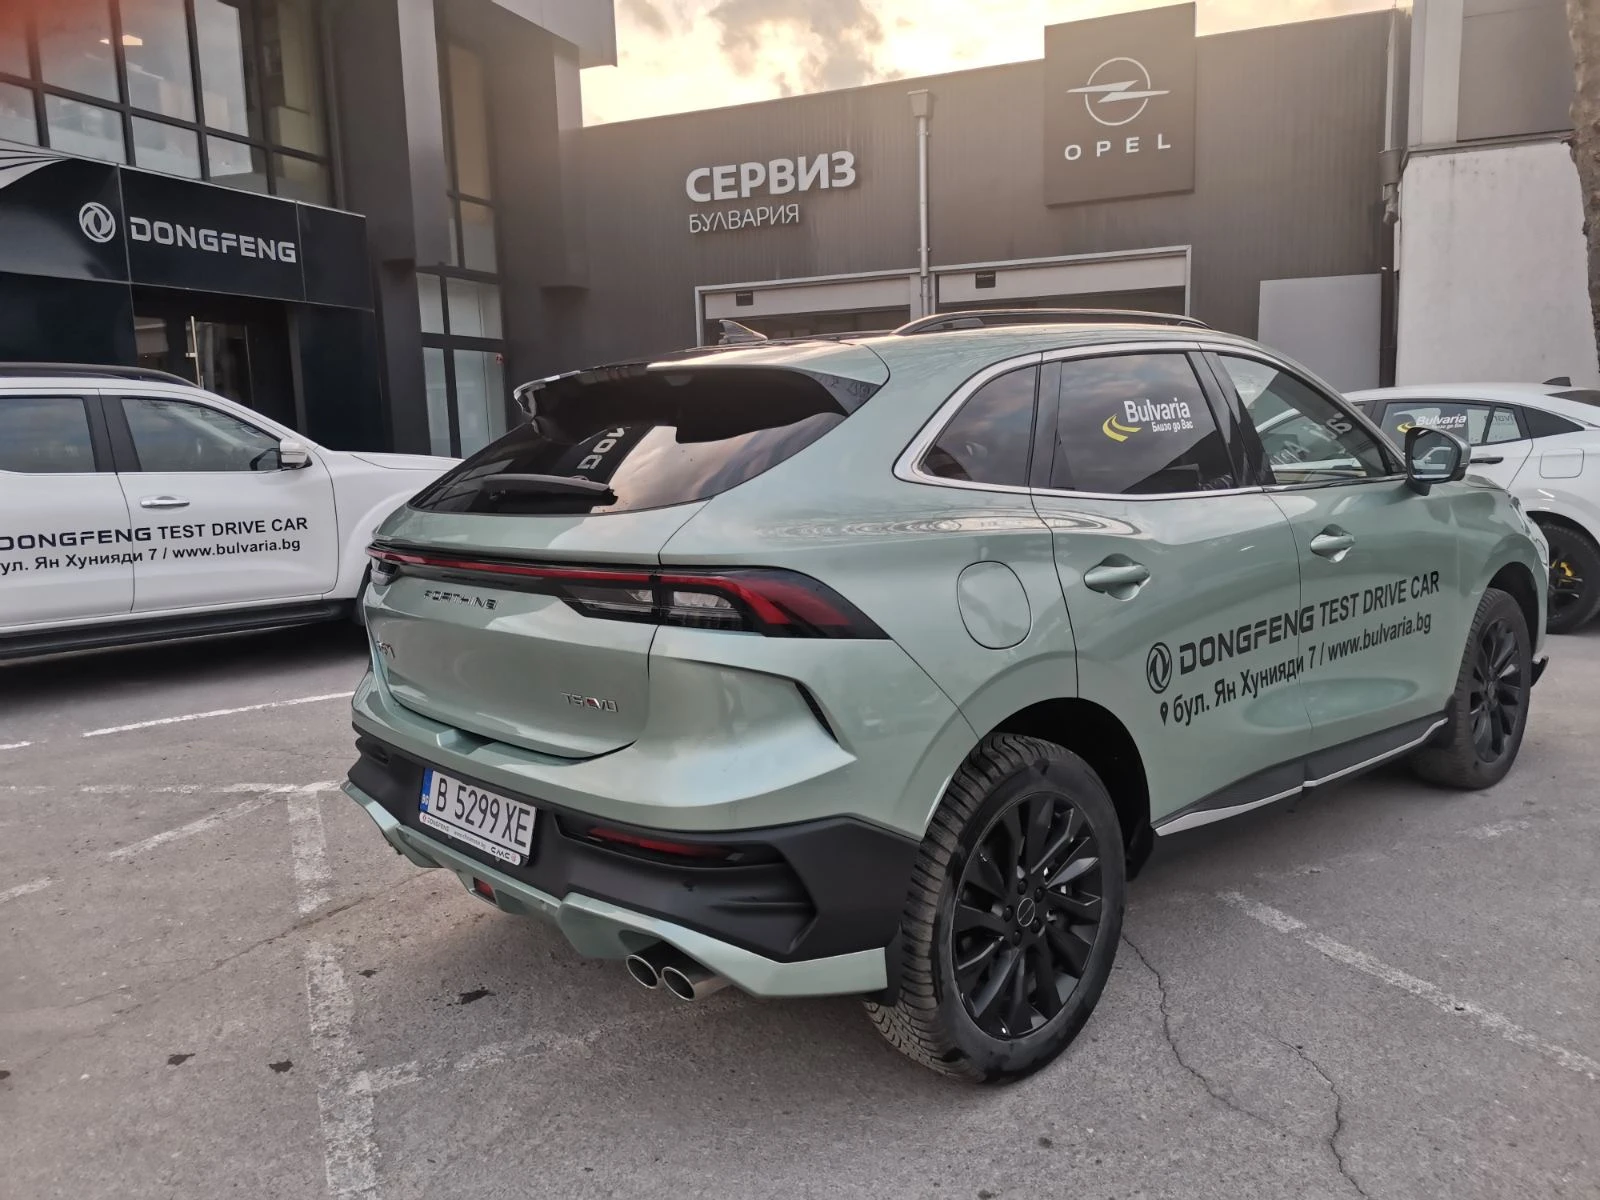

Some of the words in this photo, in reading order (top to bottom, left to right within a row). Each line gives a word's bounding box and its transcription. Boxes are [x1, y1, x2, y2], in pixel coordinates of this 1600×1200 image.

[1064, 133, 1172, 161] OPEL
[685, 150, 857, 203] СЕРВИЗ
[688, 203, 800, 234] БУЛВАРИЯ
[130, 216, 297, 264] DONGFENG
[1123, 397, 1191, 423] Bulvaria
[1416, 413, 1467, 427] Bulvaria
[157, 523, 206, 540] TEST
[211, 520, 266, 537] DRIVE
[271, 517, 308, 532] CAR
[35, 556, 60, 570] Ян
[65, 551, 143, 570] Хунияди
[149, 548, 158, 561] 7
[162, 547, 168, 560] /
[172, 538, 301, 559] www.bulvaria.bg
[1179, 605, 1315, 676] DONGFENG
[1319, 592, 1359, 628] TEST
[1362, 579, 1408, 615] DRIVE
[1410, 570, 1440, 599] CAR
[1173, 694, 1211, 727] бул.
[1214, 678, 1237, 707] Ян
[1239, 655, 1305, 699] Хунияди
[1308, 645, 1317, 670] 7
[1327, 611, 1432, 662] www.bulvaria.bg
[435, 777, 448, 812] B
[454, 784, 500, 833] 5299
[501, 801, 531, 848] XE
